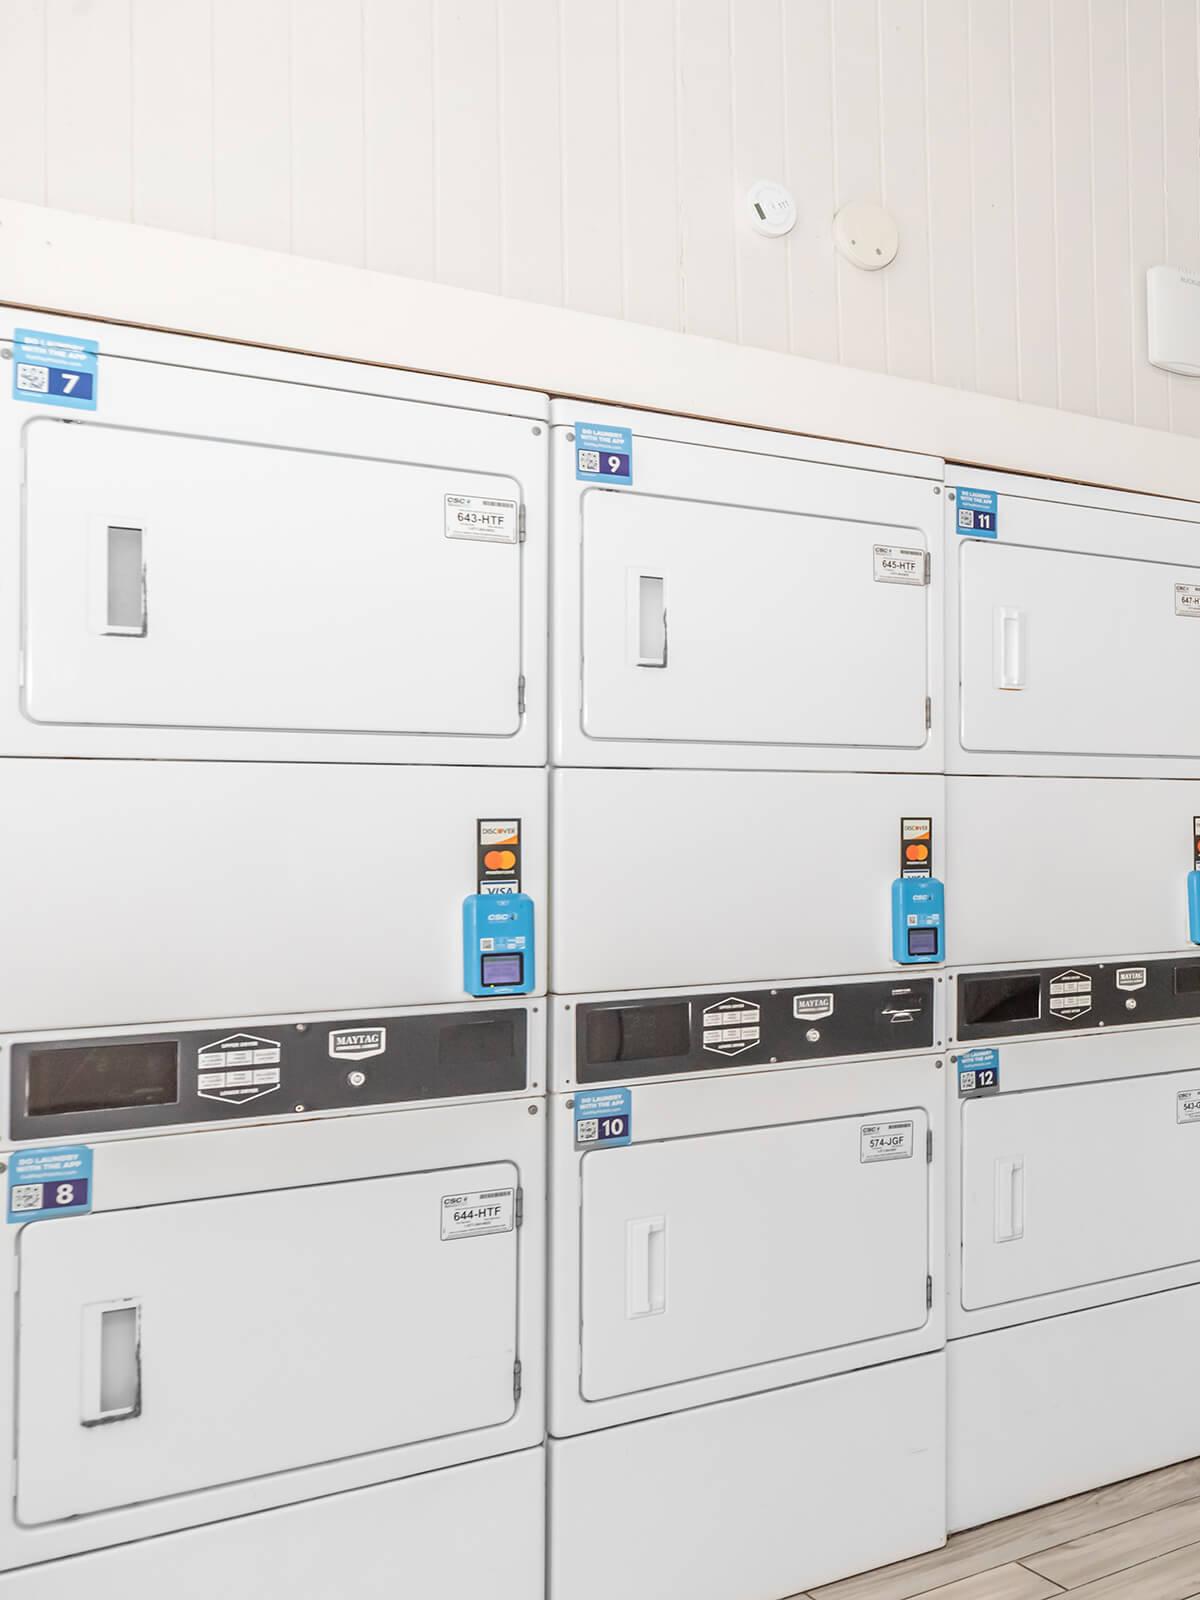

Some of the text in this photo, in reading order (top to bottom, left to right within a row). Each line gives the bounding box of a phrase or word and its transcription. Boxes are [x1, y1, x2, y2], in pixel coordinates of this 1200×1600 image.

[61, 373, 80, 394] 7
[608, 456, 621, 473] 9
[457, 511, 505, 526] 643-HTF
[978, 513, 990, 529] 11
[882, 559, 916, 571] 645-HTF
[482, 827, 516, 835] DISCOVER
[799, 998, 830, 1008] MAYTAG
[336, 1033, 380, 1046] MAYTAG
[978, 1070, 993, 1086] 12
[602, 1118, 624, 1137] 10
[869, 1135, 905, 1149] 574-JGF
[55, 1183, 75, 1205] 8
[444, 1197, 463, 1205] CSC
[453, 1206, 502, 1222] 644-HTF
